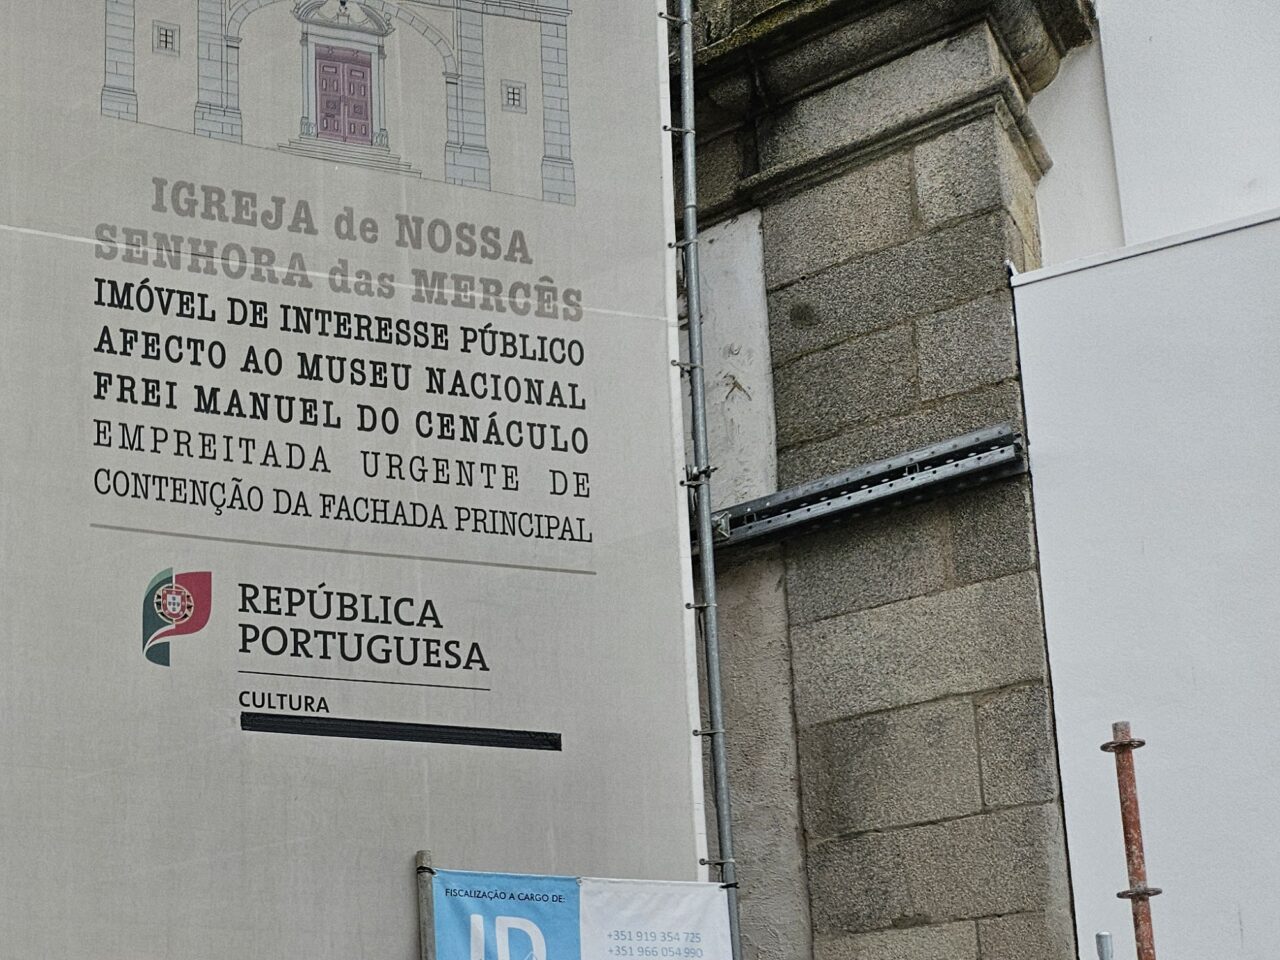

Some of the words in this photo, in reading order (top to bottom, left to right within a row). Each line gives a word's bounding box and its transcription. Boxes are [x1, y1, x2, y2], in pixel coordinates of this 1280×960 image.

[152, 177, 317, 234] IGREJA
[335, 207, 378, 243] de
[395, 213, 533, 264] NOSSA
[94, 223, 312, 289] SENHORA
[328, 259, 396, 299] das
[412, 268, 584, 322] MERCÊS
[94, 278, 216, 321] IMÓVEL
[227, 297, 268, 328] DE
[280, 304, 448, 351] INTERESSE
[460, 323, 584, 366] PÚBLICO
[94, 326, 226, 369] AFECTO
[241, 345, 282, 376] AO
[297, 352, 411, 391] MUSEU
[426, 368, 586, 410] NACIONAL
[94, 372, 178, 409] FREI
[194, 385, 341, 429] MANUEL
[357, 404, 399, 434] DO
[415, 411, 588, 454] CENÁCULO
[94, 419, 331, 474] EMPREITADA
[361, 451, 519, 491] URGENTE
[549, 469, 590, 498] DE
[94, 468, 263, 515] CONTENÇÃO
[273, 489, 311, 518] DA
[319, 494, 447, 530] FACHADA
[455, 506, 592, 542] PRINCIPAL
[238, 582, 443, 629] REPÚBLICA
[238, 624, 490, 672] PORTUGUESA
[238, 691, 330, 714] CULTURA
[445, 889, 507, 900] FISCALIZAÇÃO
[509, 891, 516, 900] A
[518, 893, 549, 902] CARGO
